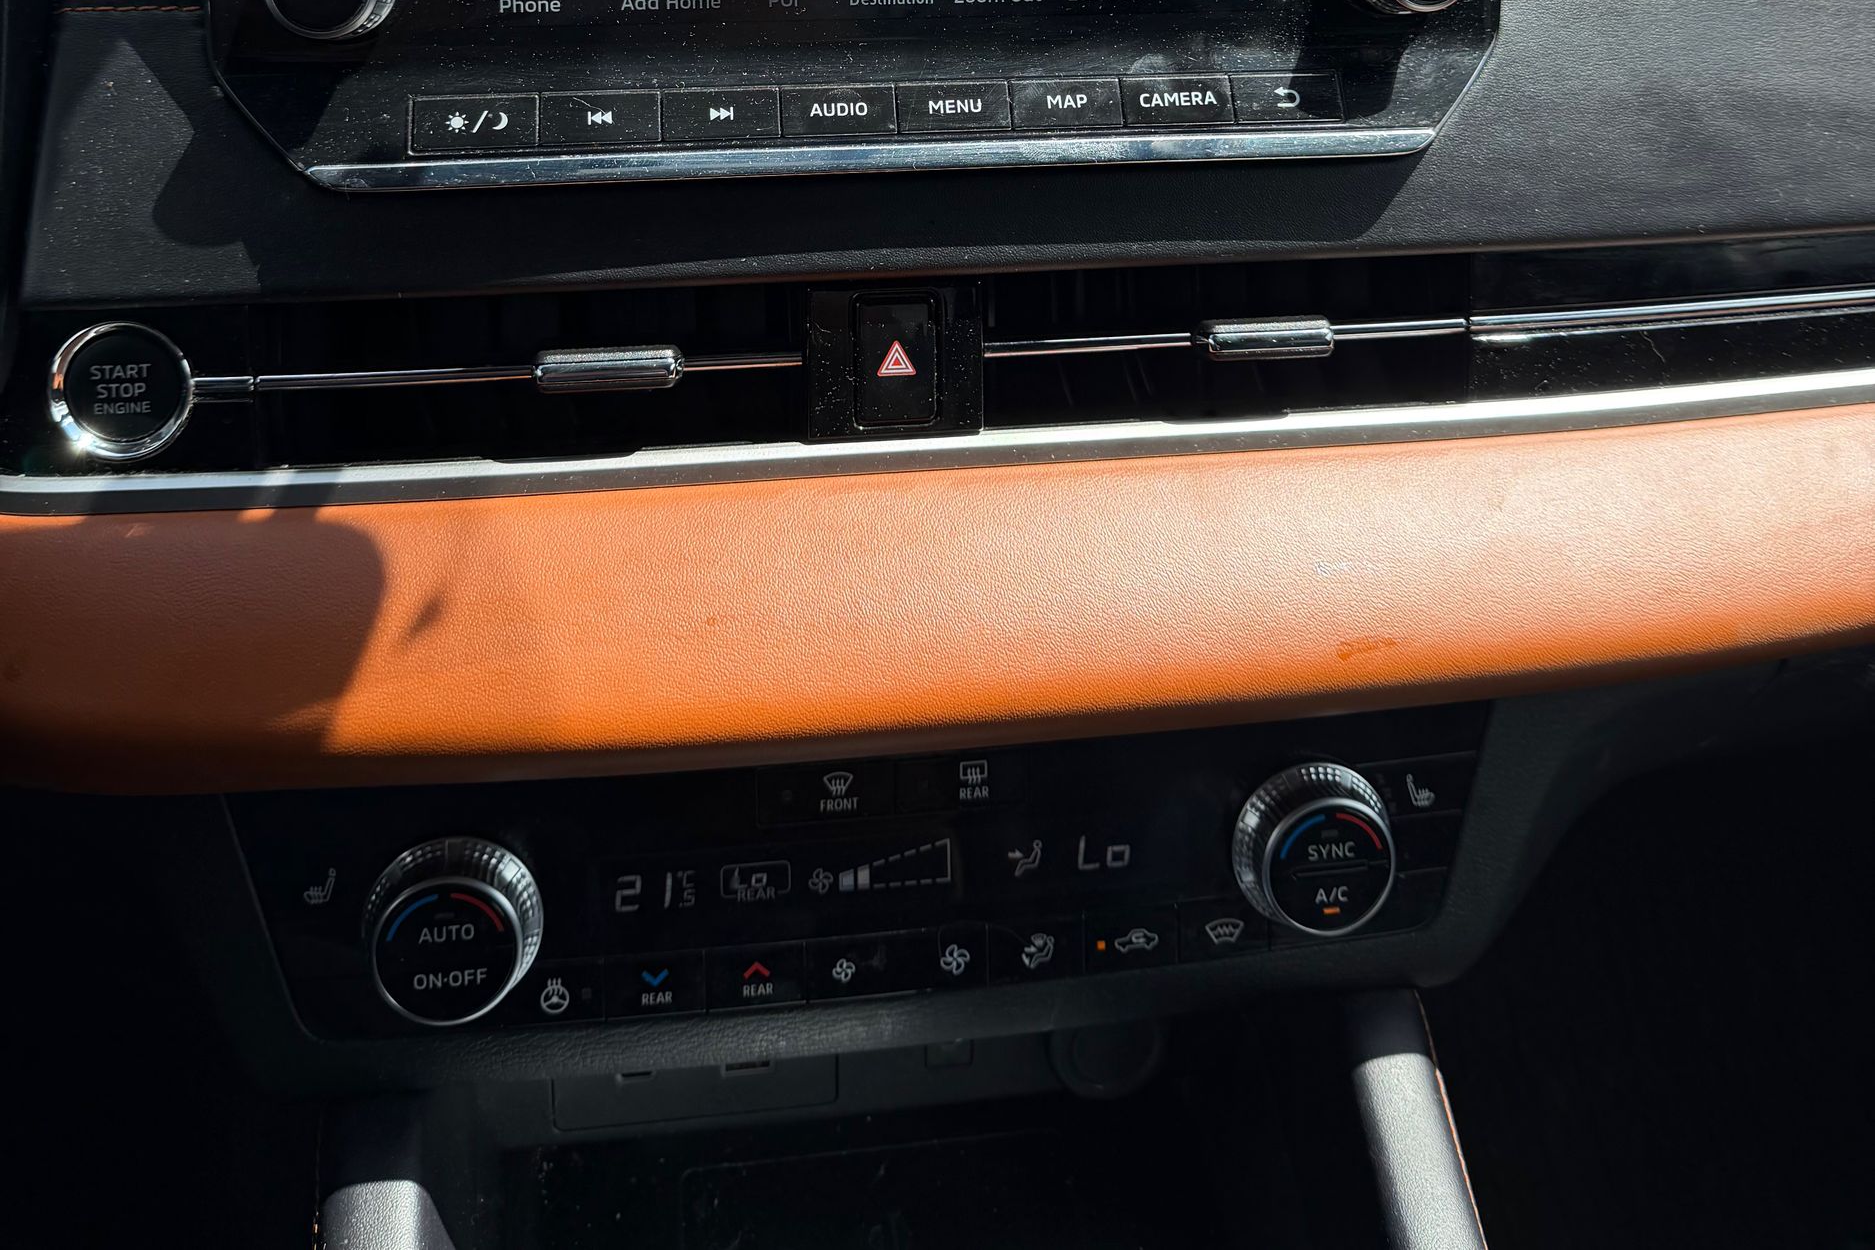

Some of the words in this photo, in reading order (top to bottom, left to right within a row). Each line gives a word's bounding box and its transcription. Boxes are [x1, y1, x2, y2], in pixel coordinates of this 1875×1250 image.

[928, 98, 982, 115] MENU
[1046, 94, 1088, 110] MAP
[1139, 90, 1217, 109] CAMERA
[809, 101, 869, 118] AUDIO
[89, 363, 152, 380] START
[96, 382, 146, 399] STOP
[93, 401, 152, 415] ENGINE
[959, 786, 989, 800] REAR
[820, 797, 859, 812] FRONT
[1307, 841, 1356, 862] SYNC
[737, 885, 776, 902] REAR
[1315, 885, 1349, 905] A/C
[418, 923, 475, 945] AUTO
[641, 991, 673, 1006] REAR
[742, 983, 774, 997] REAR
